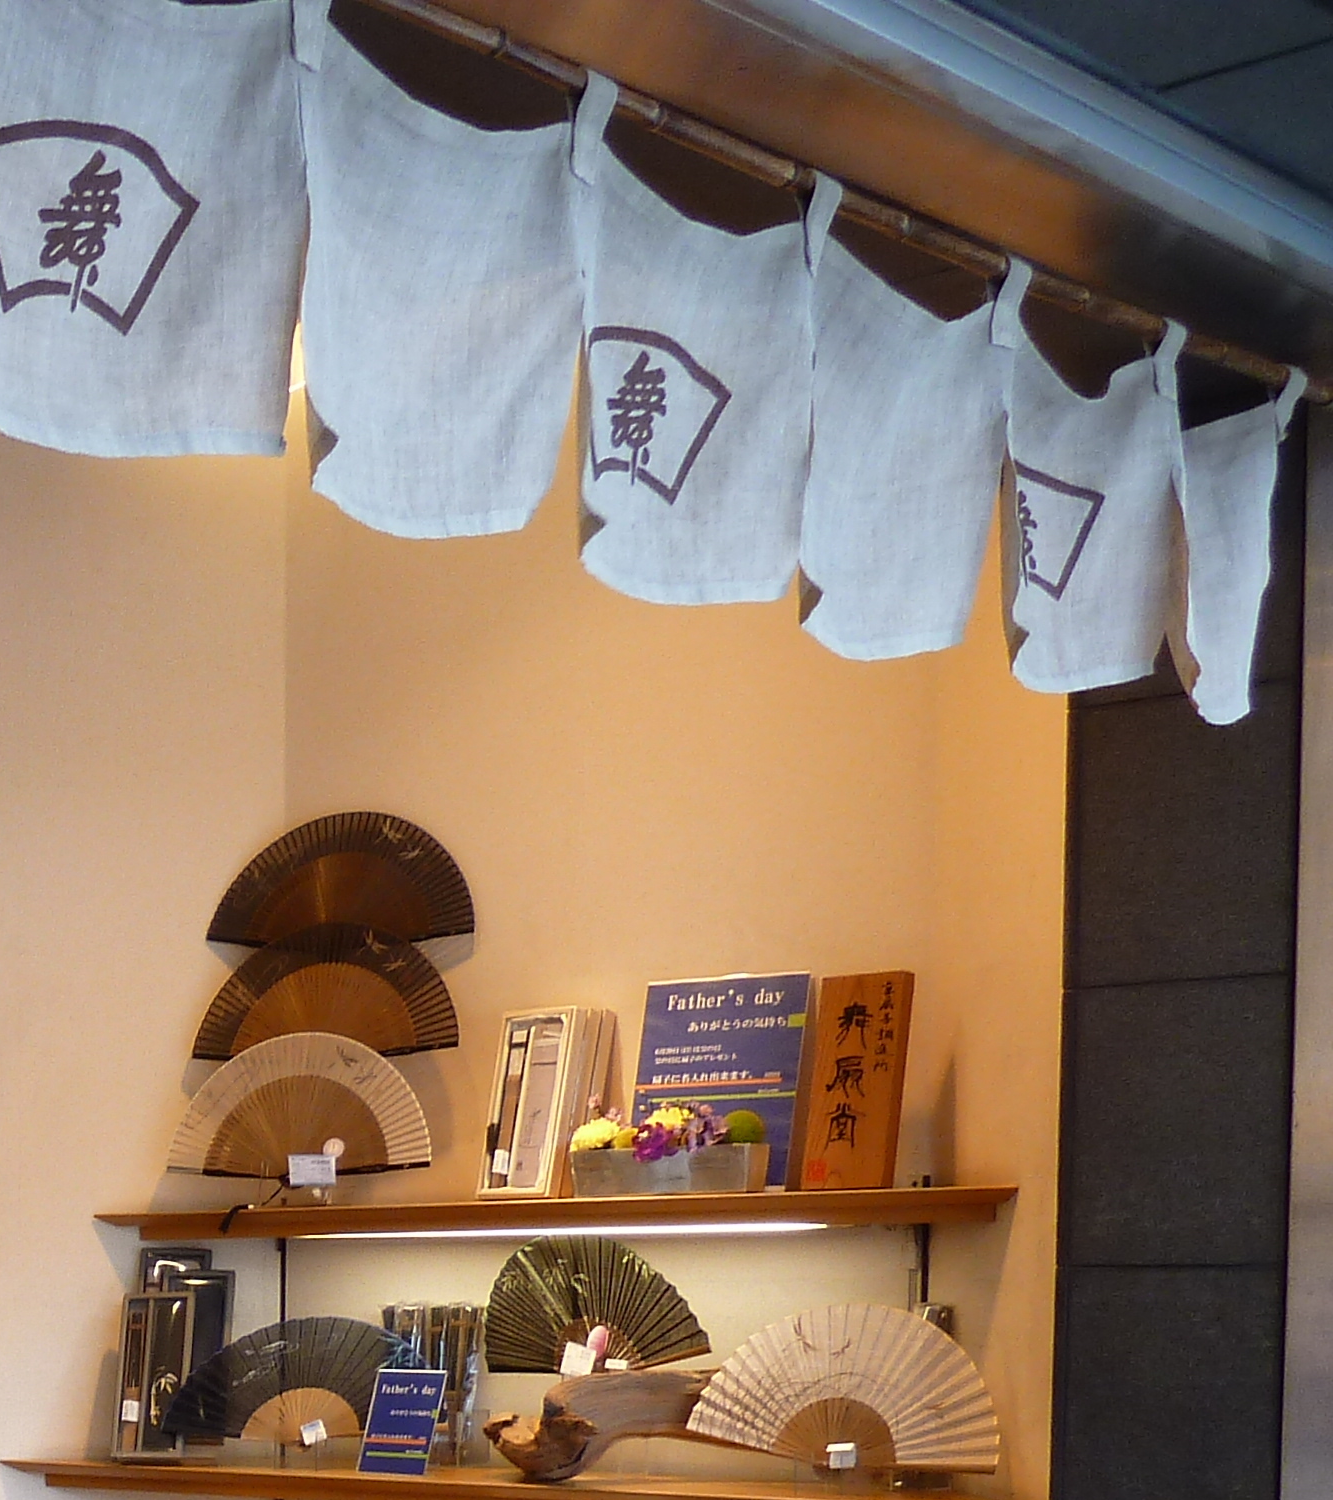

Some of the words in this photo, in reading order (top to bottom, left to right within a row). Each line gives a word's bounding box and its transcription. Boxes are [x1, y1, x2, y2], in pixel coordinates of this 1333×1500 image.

[667, 988, 745, 1012] Father's
[754, 987, 785, 1006] day
[381, 1383, 418, 1395] Father's
[421, 1384, 437, 1397] day
